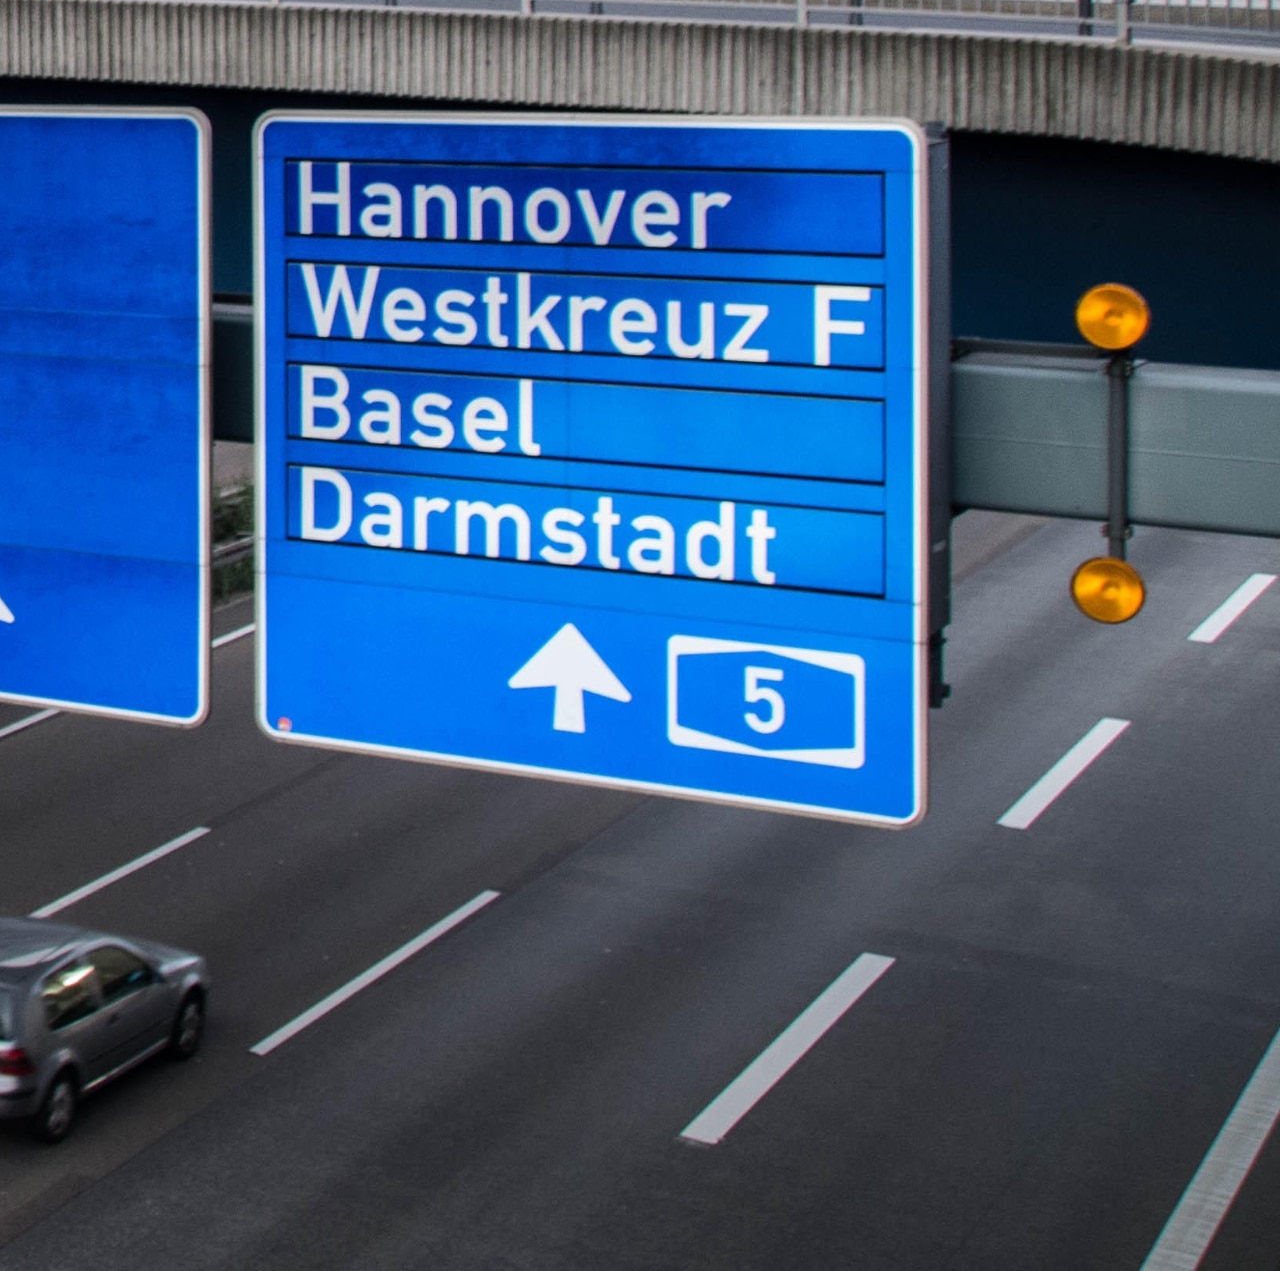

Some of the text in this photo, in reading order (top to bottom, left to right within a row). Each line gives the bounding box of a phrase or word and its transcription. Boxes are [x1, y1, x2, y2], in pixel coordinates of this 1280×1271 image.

[299, 161, 732, 250] Hannover
[301, 263, 872, 367] Westkreuz F
[300, 365, 541, 457] Basel
[300, 466, 777, 586] Darmstadt
[743, 665, 786, 734] 5
